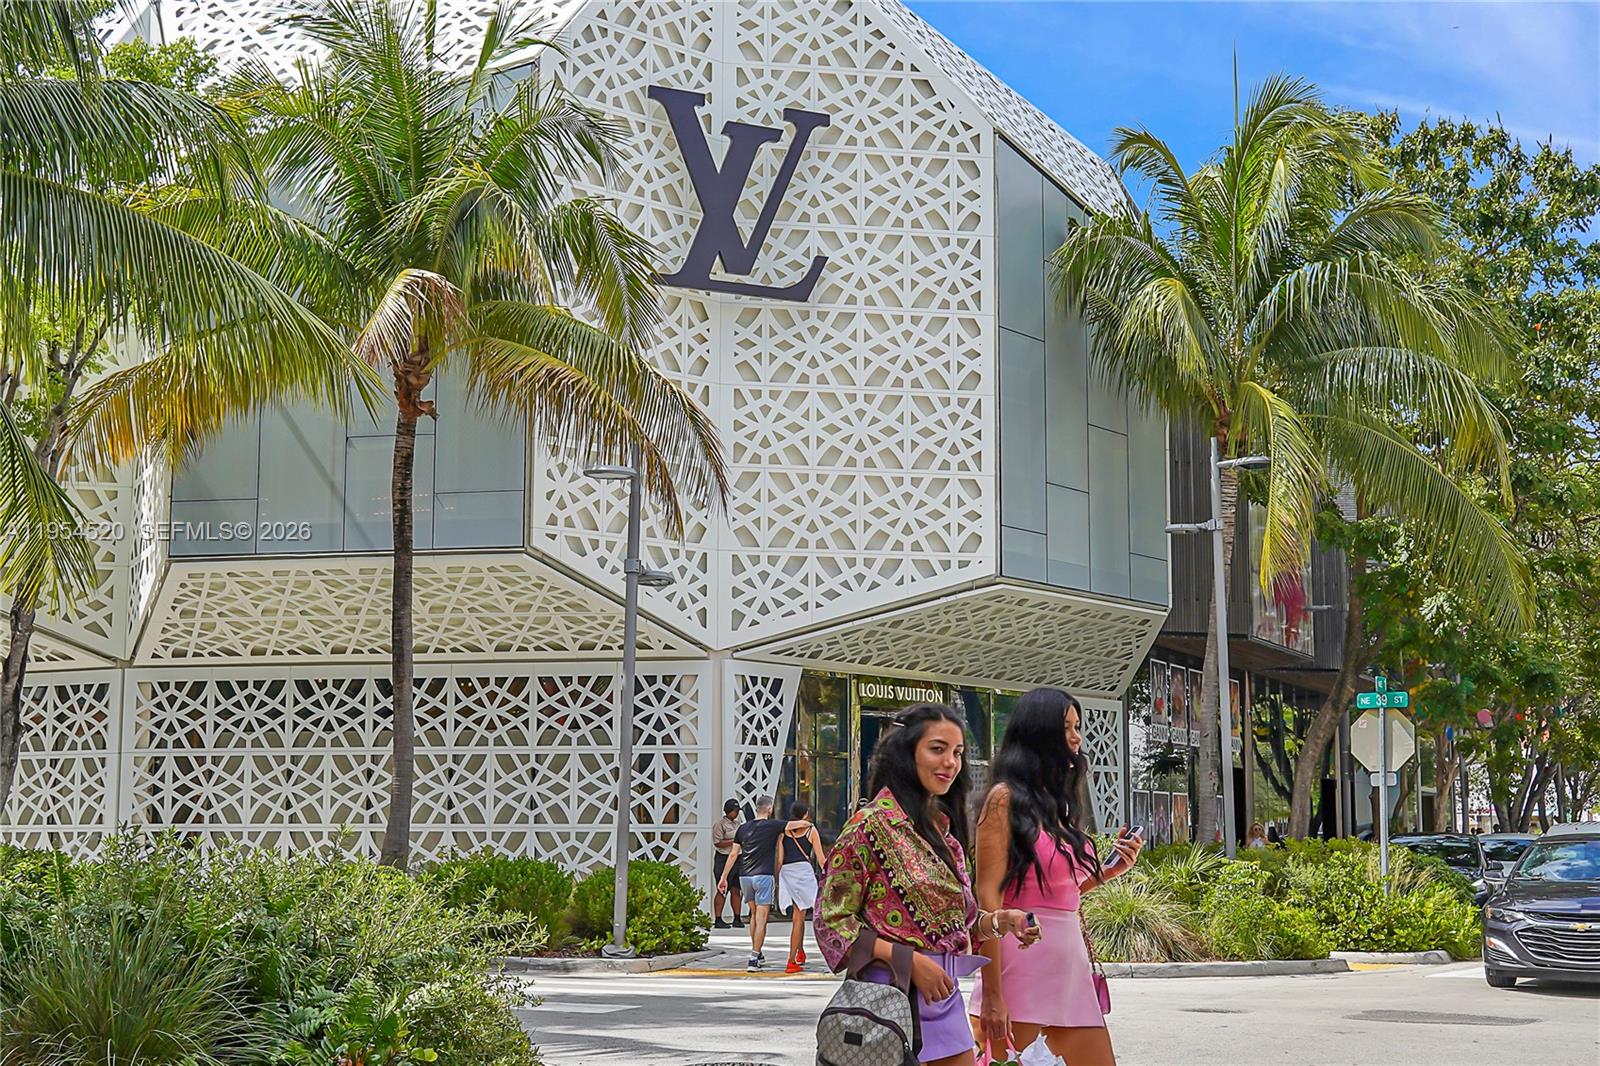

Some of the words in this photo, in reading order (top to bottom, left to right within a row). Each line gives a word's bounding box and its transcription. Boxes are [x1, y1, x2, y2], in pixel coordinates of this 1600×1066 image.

[859, 683, 894, 699] LOUIS
[895, 686, 943, 703] VUITTON
[1376, 694, 1387, 706] 39
